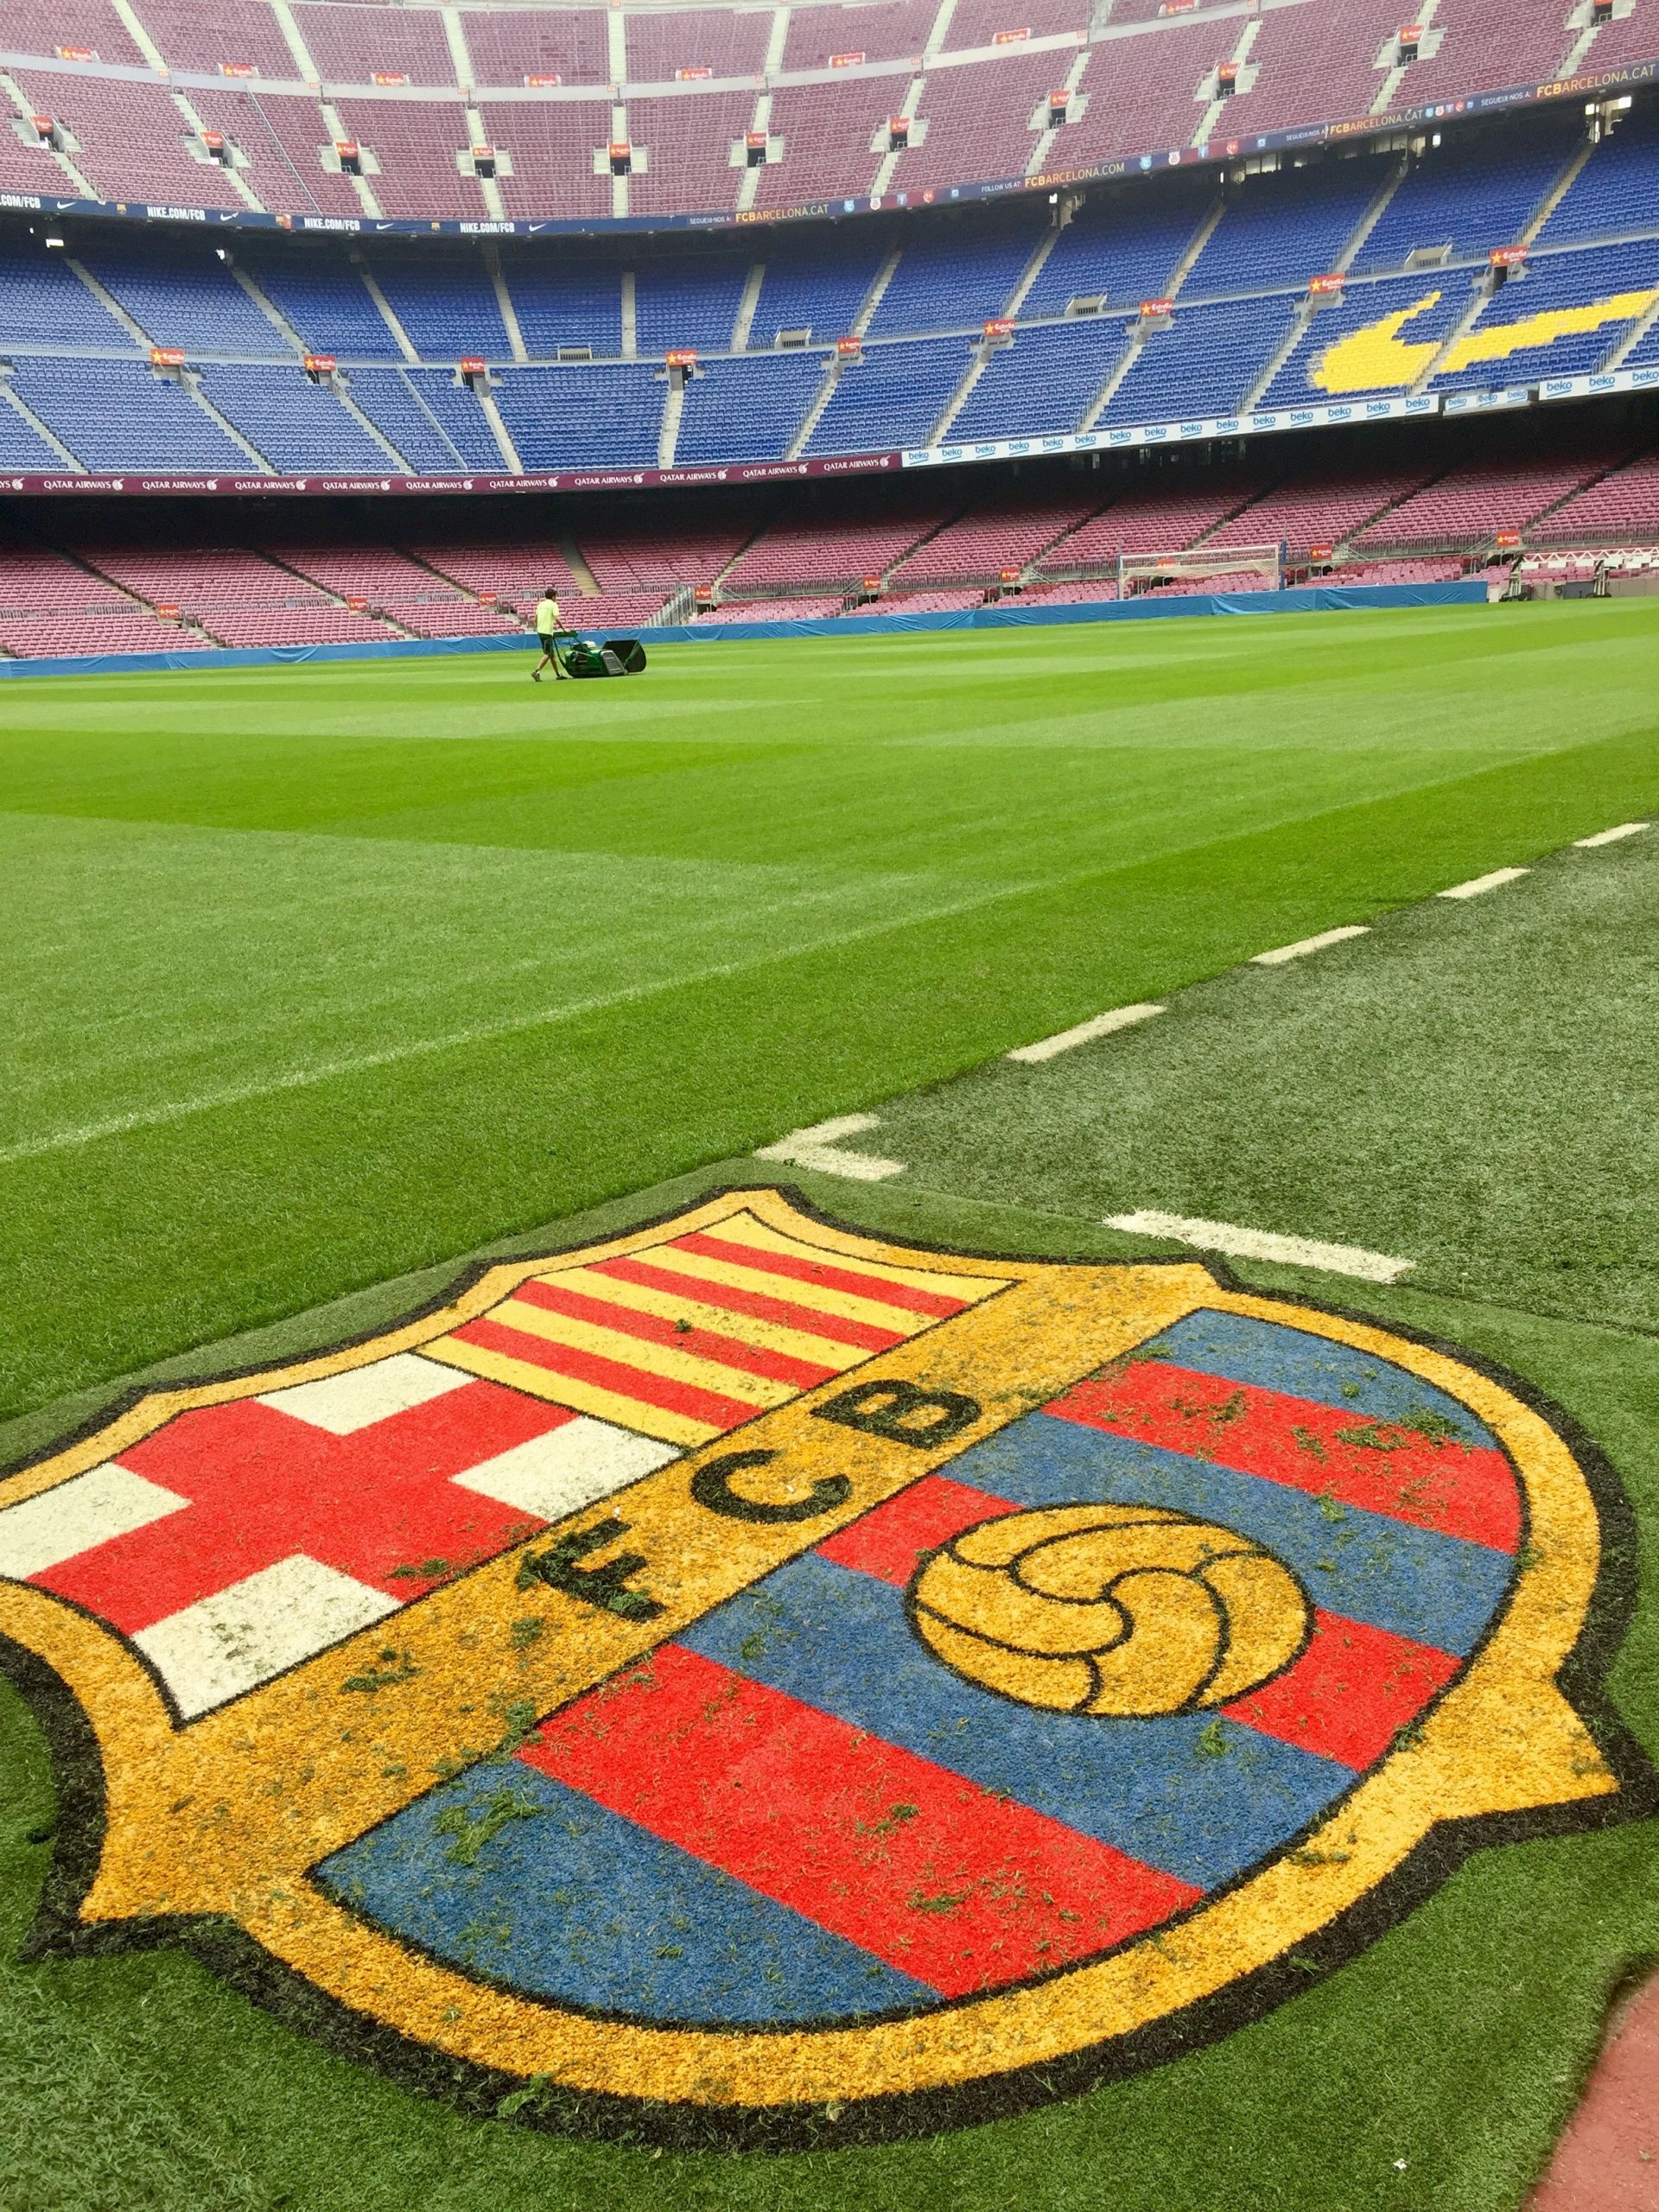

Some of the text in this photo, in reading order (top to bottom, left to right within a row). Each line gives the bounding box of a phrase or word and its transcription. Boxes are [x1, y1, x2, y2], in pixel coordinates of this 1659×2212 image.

[1536, 64, 1656, 98] FCBARCELONA.CAT
[1330, 109, 1424, 135] FCBARCELONACAT
[1025, 162, 1125, 188] FCBARCELONA.COM
[147, 206, 206, 221] NIKE.COM/FCB
[735, 204, 830, 223] FCBARCELONA.CAT
[304, 217, 360, 231] NIKE.COM/FCB
[460, 222, 515, 233] NIKE.COM/FCB
[1589, 376, 1615, 386] beko
[1632, 371, 1659, 381] beko
[1547, 381, 1573, 391] beko
[1366, 402, 1390, 412] beko
[1406, 397, 1430, 408] beko
[1290, 411, 1313, 421] beko
[1328, 407, 1351, 416] beko
[1217, 419, 1238, 429] beko
[1253, 415, 1275, 425] beko
[1145, 427, 1166, 436] beko
[1180, 423, 1203, 433] beko
[1075, 434, 1096, 444] beko
[1109, 430, 1131, 440] beko
[1008, 441, 1029, 451] beko
[1043, 437, 1064, 448] beko
[942, 448, 963, 457] beko
[976, 444, 995, 454] beko
[908, 450, 929, 460] beko
[823, 460, 879, 471] QATAR AIRWAYS
[659, 472, 716, 482] QATAR AIRWAYS
[743, 467, 798, 478] QATAR AIRWAYS
[44, 480, 111, 489] QATAR AIRWAYS
[143, 480, 207, 489] QATAR AIRWAYS
[235, 481, 262, 490] QATAR
[322, 481, 348, 490] QATAR
[489, 479, 548, 488] QATAR AIRWAYS
[575, 475, 632, 486] QATAR AIRWAYS
